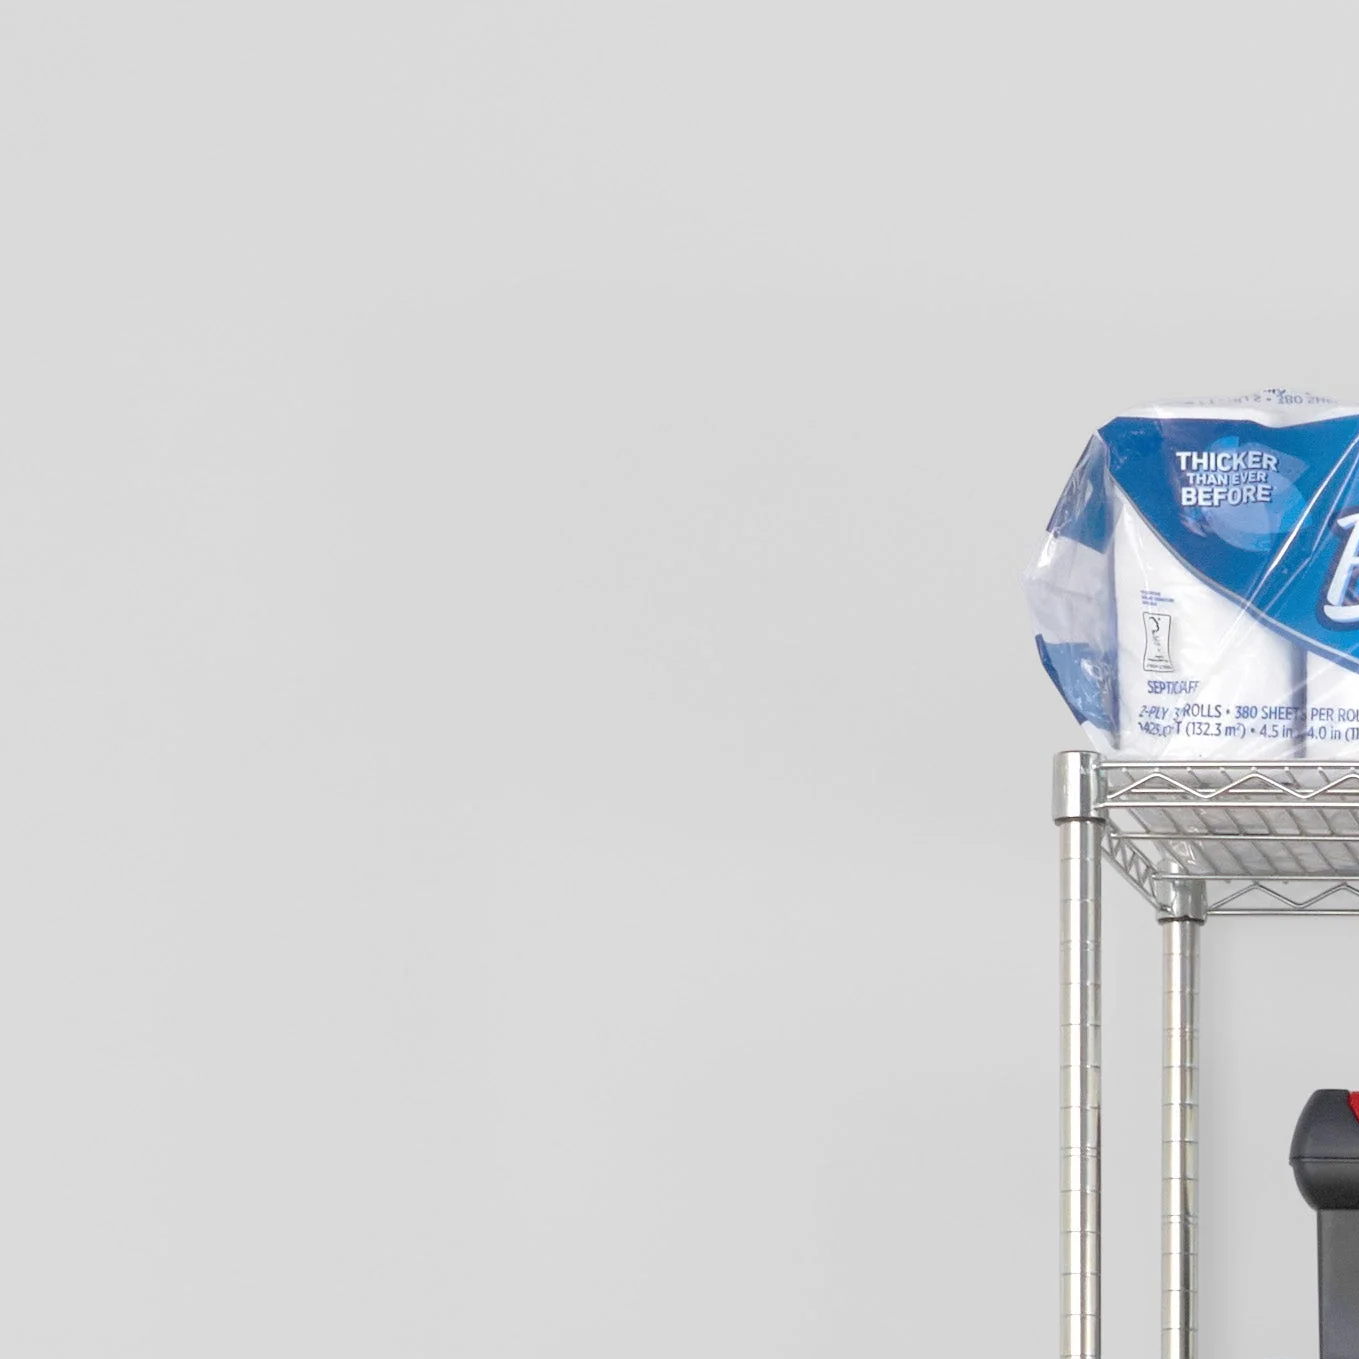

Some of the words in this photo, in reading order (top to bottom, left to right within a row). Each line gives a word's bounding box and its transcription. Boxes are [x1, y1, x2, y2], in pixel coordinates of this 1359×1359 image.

[1176, 451, 1278, 472] THICKER
[1187, 473, 1228, 485] THAN
[1231, 471, 1267, 484] EVER
[1181, 485, 1272, 506] BEFORE
[1311, 708, 1335, 721] PER
